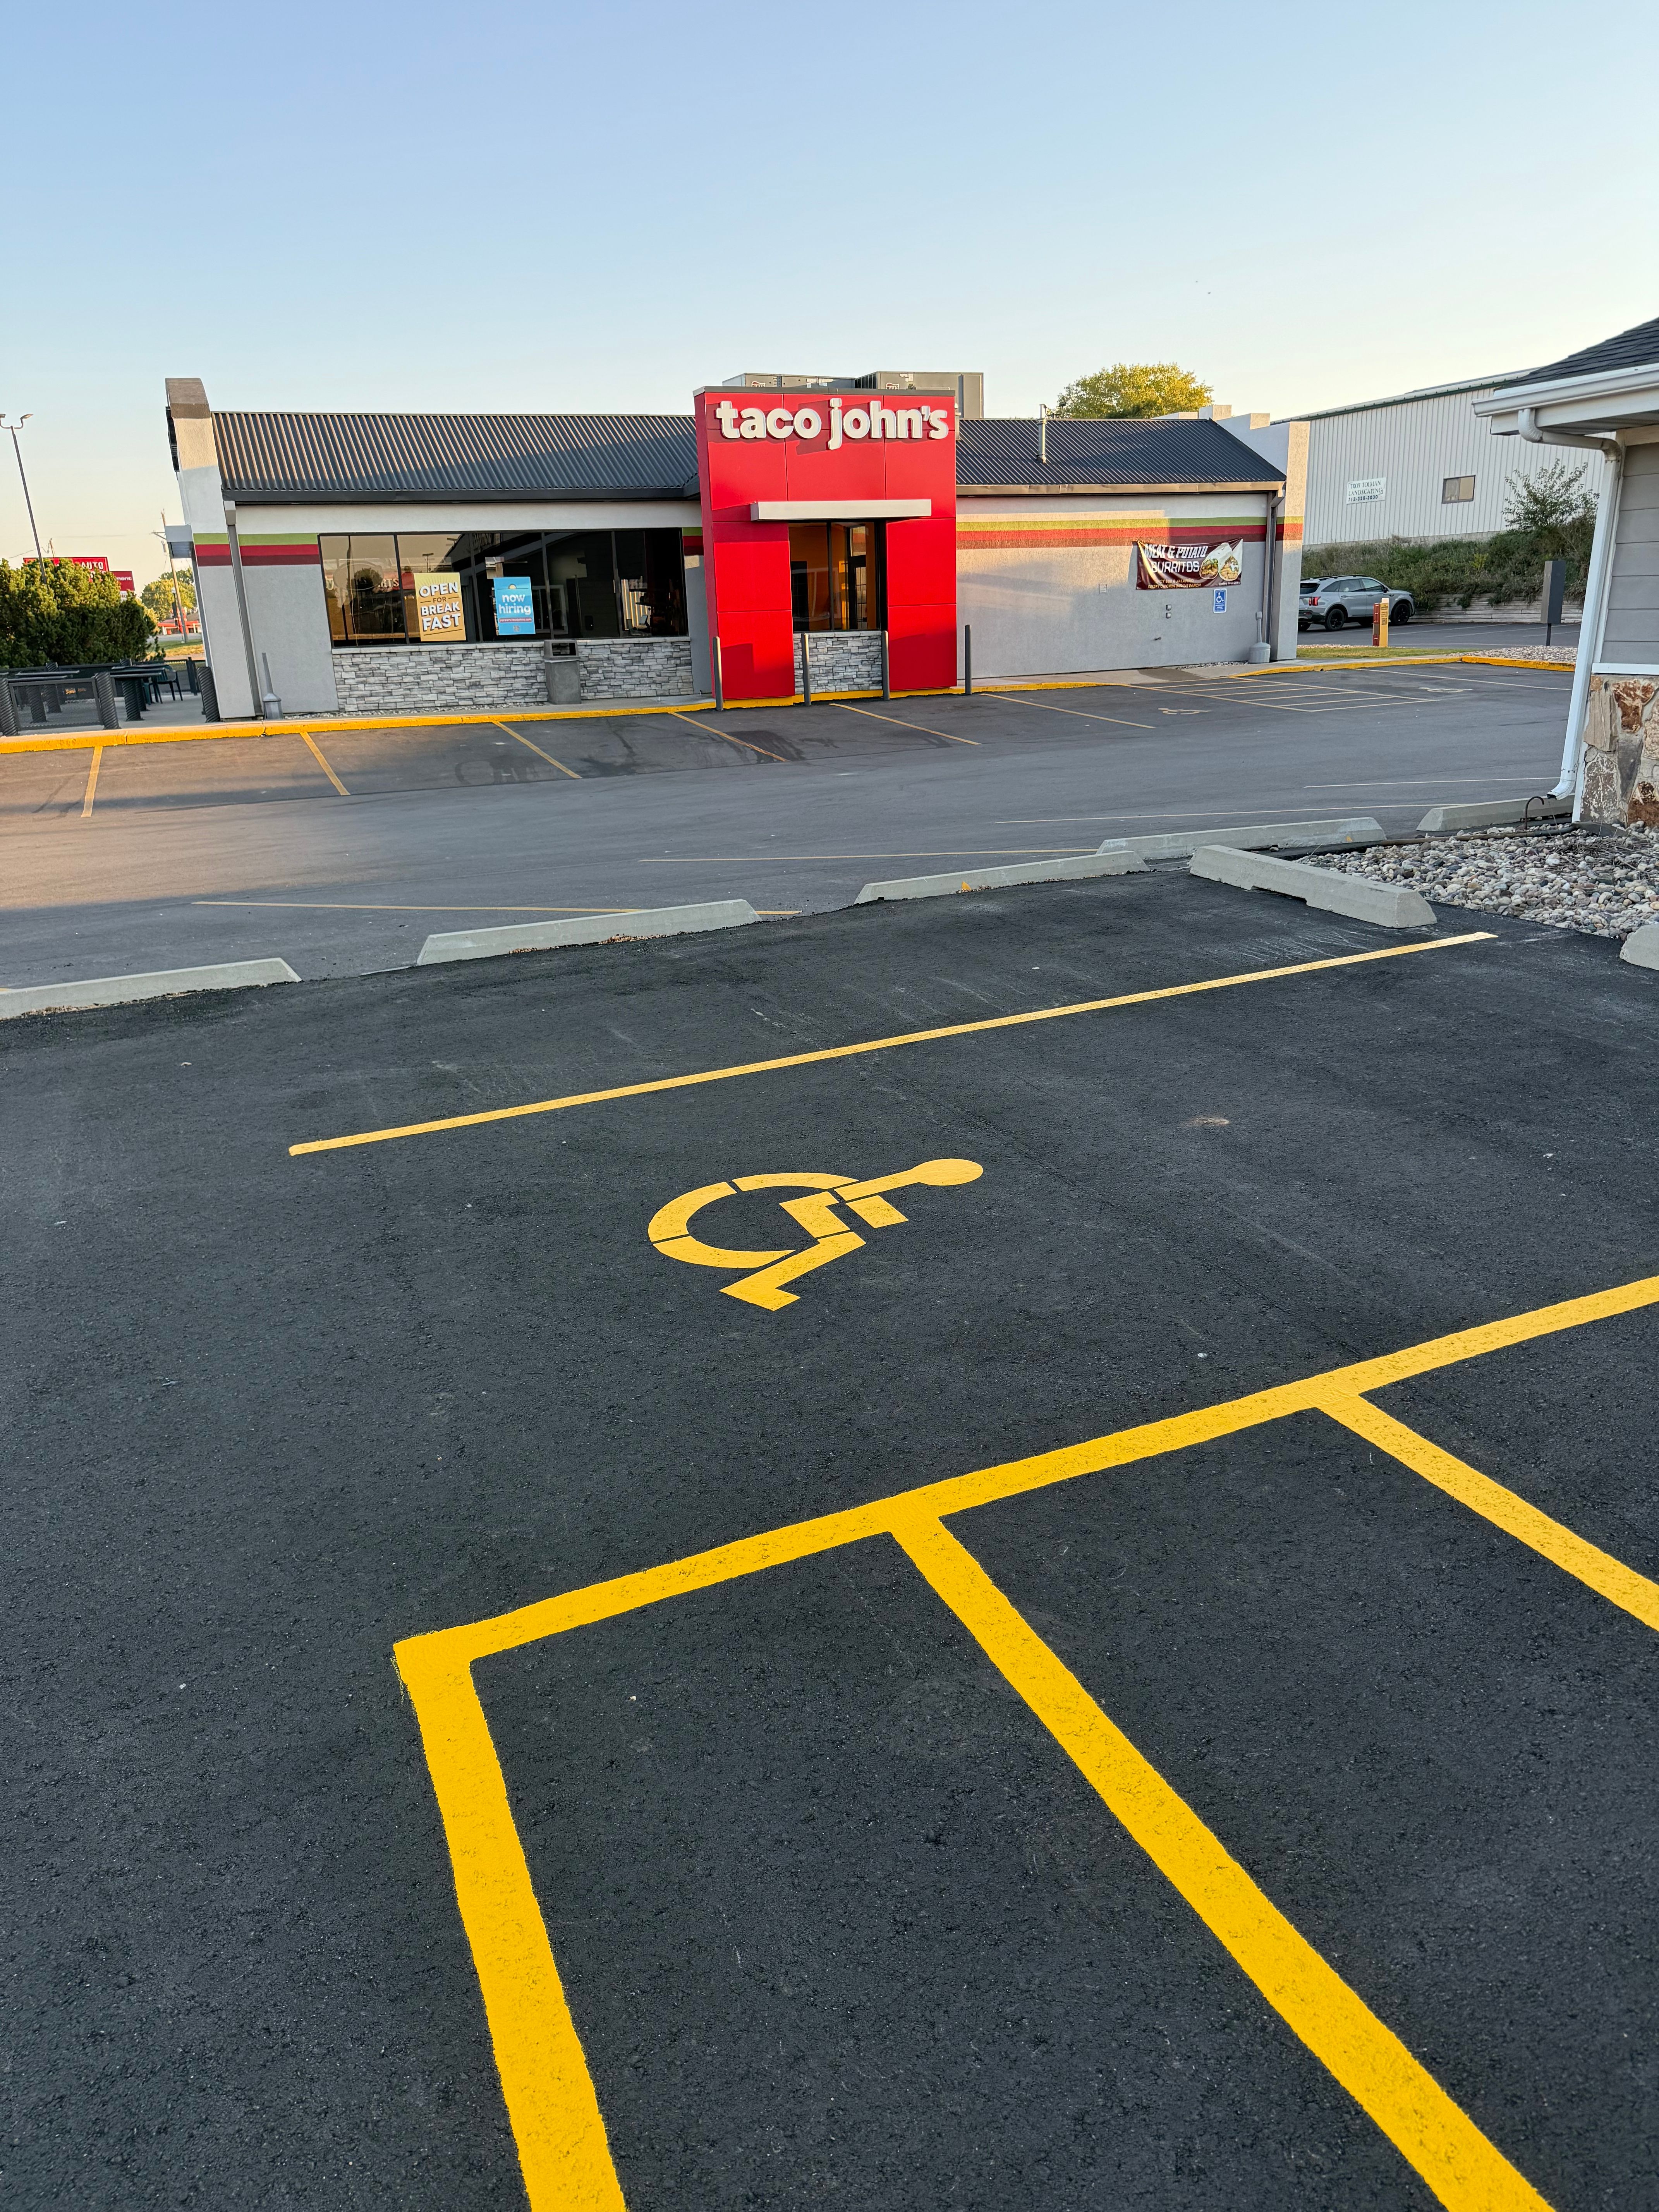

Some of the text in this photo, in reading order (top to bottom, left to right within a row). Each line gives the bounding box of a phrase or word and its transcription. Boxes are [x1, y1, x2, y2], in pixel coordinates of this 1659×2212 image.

[716, 398, 948, 450] taco john's
[1348, 488, 1382, 496] LANDSCAPING
[1144, 544, 1167, 558] MEAT
[1167, 546, 1175, 559] &
[81, 562, 104, 570] AUTO
[1152, 561, 1200, 573] BURRITOS
[419, 582, 459, 598] OPEN
[502, 594, 526, 603] now
[421, 602, 460, 616] BREAK
[498, 603, 531, 615] hiring
[422, 613, 461, 632] FAST
